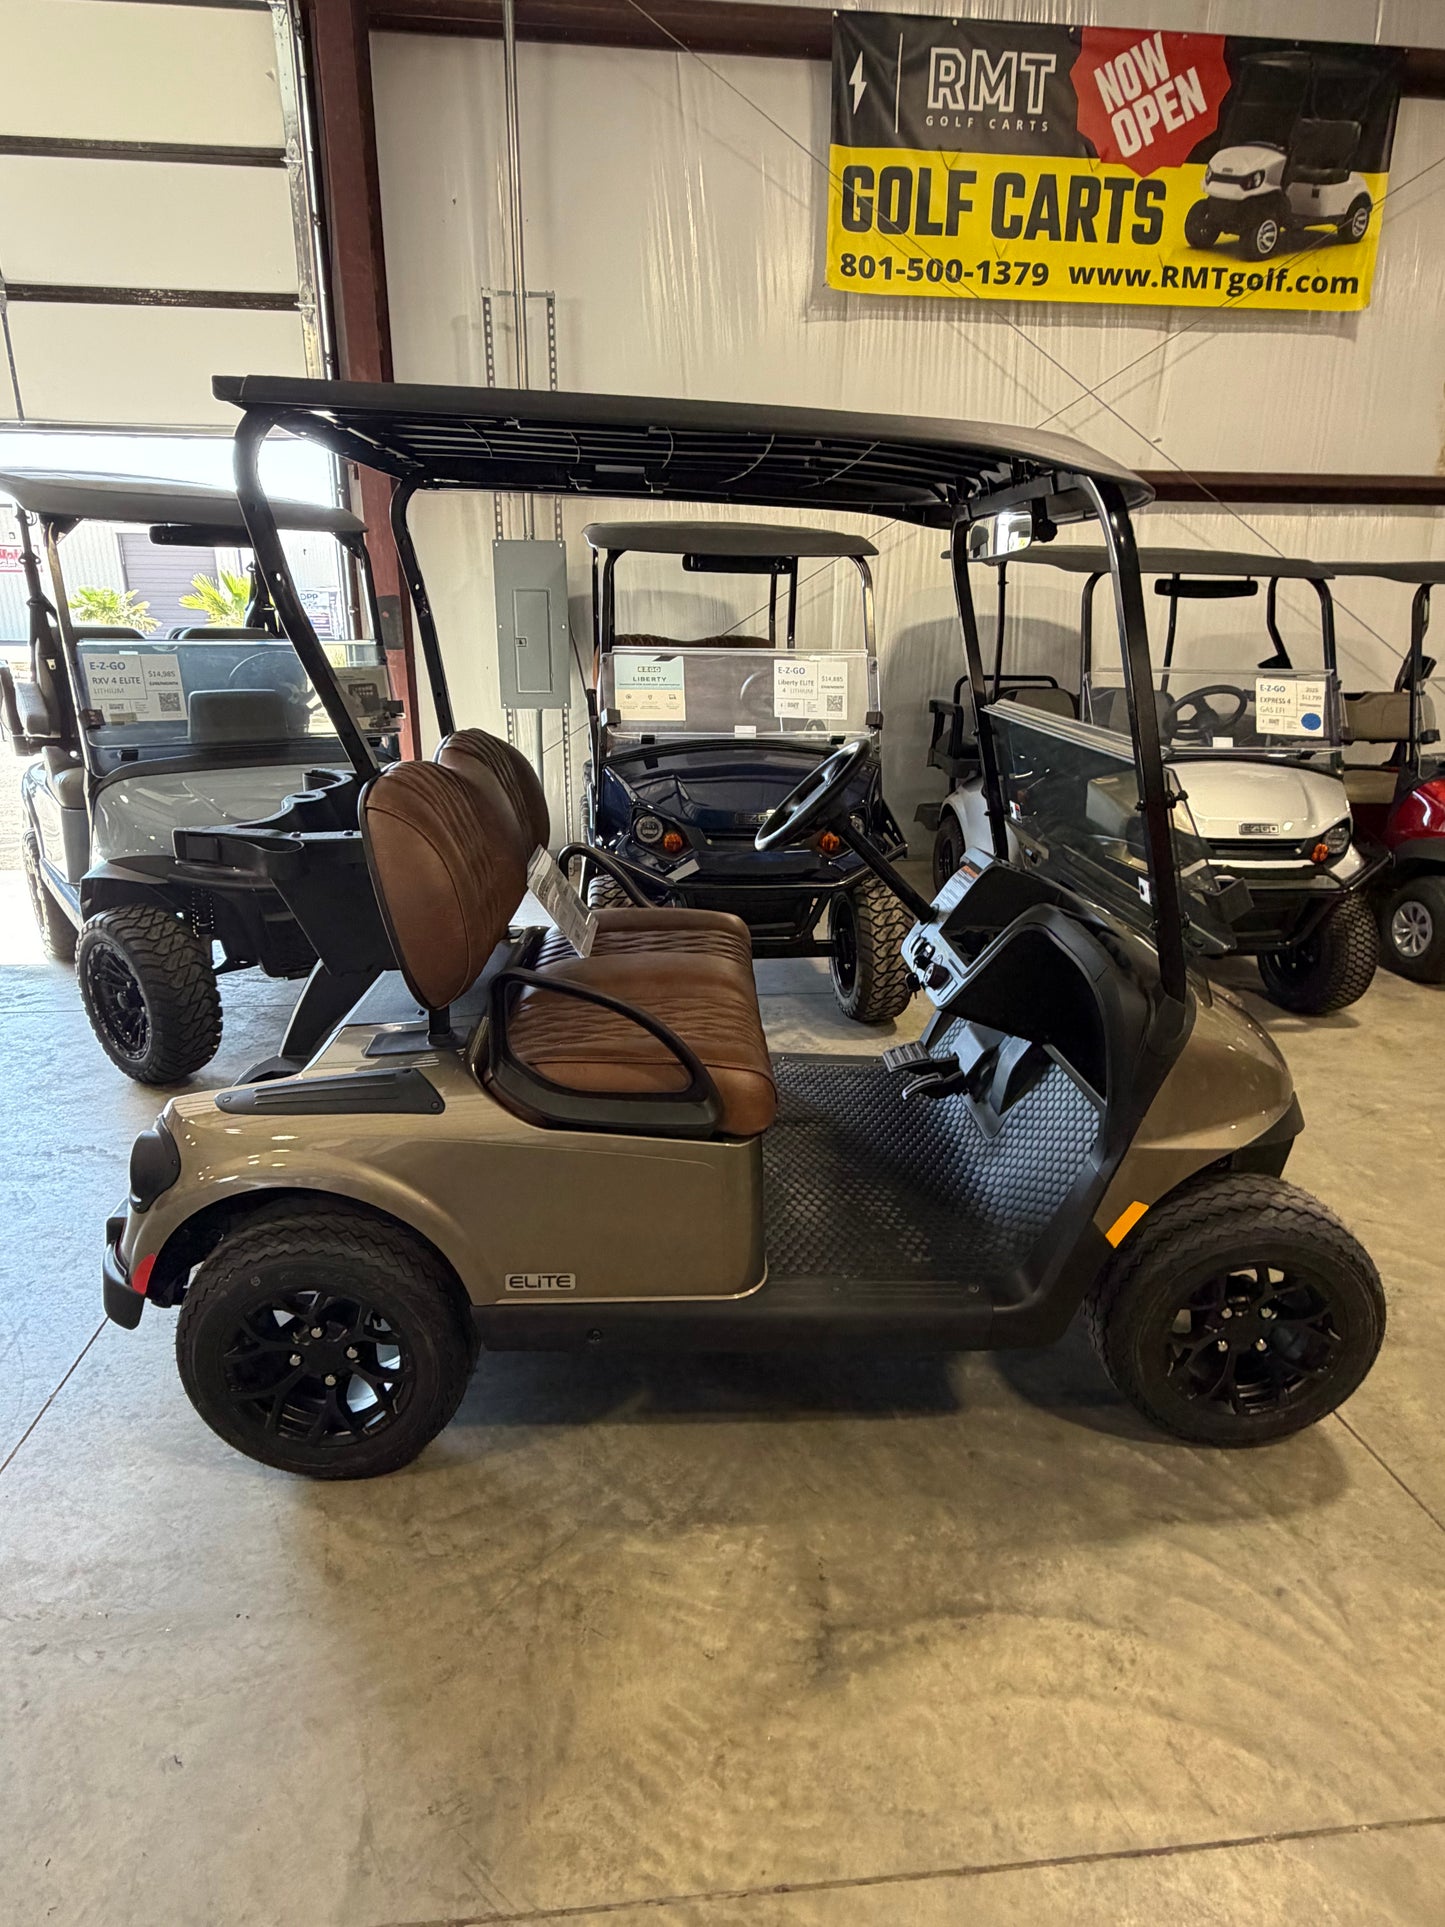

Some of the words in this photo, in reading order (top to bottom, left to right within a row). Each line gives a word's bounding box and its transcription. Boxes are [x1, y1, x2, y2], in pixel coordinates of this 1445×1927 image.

[927, 47, 1057, 114] RMT
[1094, 31, 1170, 114] NOW
[926, 115, 974, 128] GOLF
[989, 117, 1048, 132] CARTS
[1111, 66, 1208, 158] OPEN
[841, 165, 977, 236] GOLF
[991, 171, 1167, 246] CARTS
[840, 252, 1050, 288] 801-500-1379
[1069, 264, 1360, 297] www.RMTgolf.com
[89, 661, 126, 671] E-Z-GO
[777, 666, 806, 675] E-Z-GO
[92, 676, 109, 685] RXV
[111, 676, 117, 685] 4
[777, 679, 799, 687] Liberty
[1259, 684, 1286, 693] E-Z-GO
